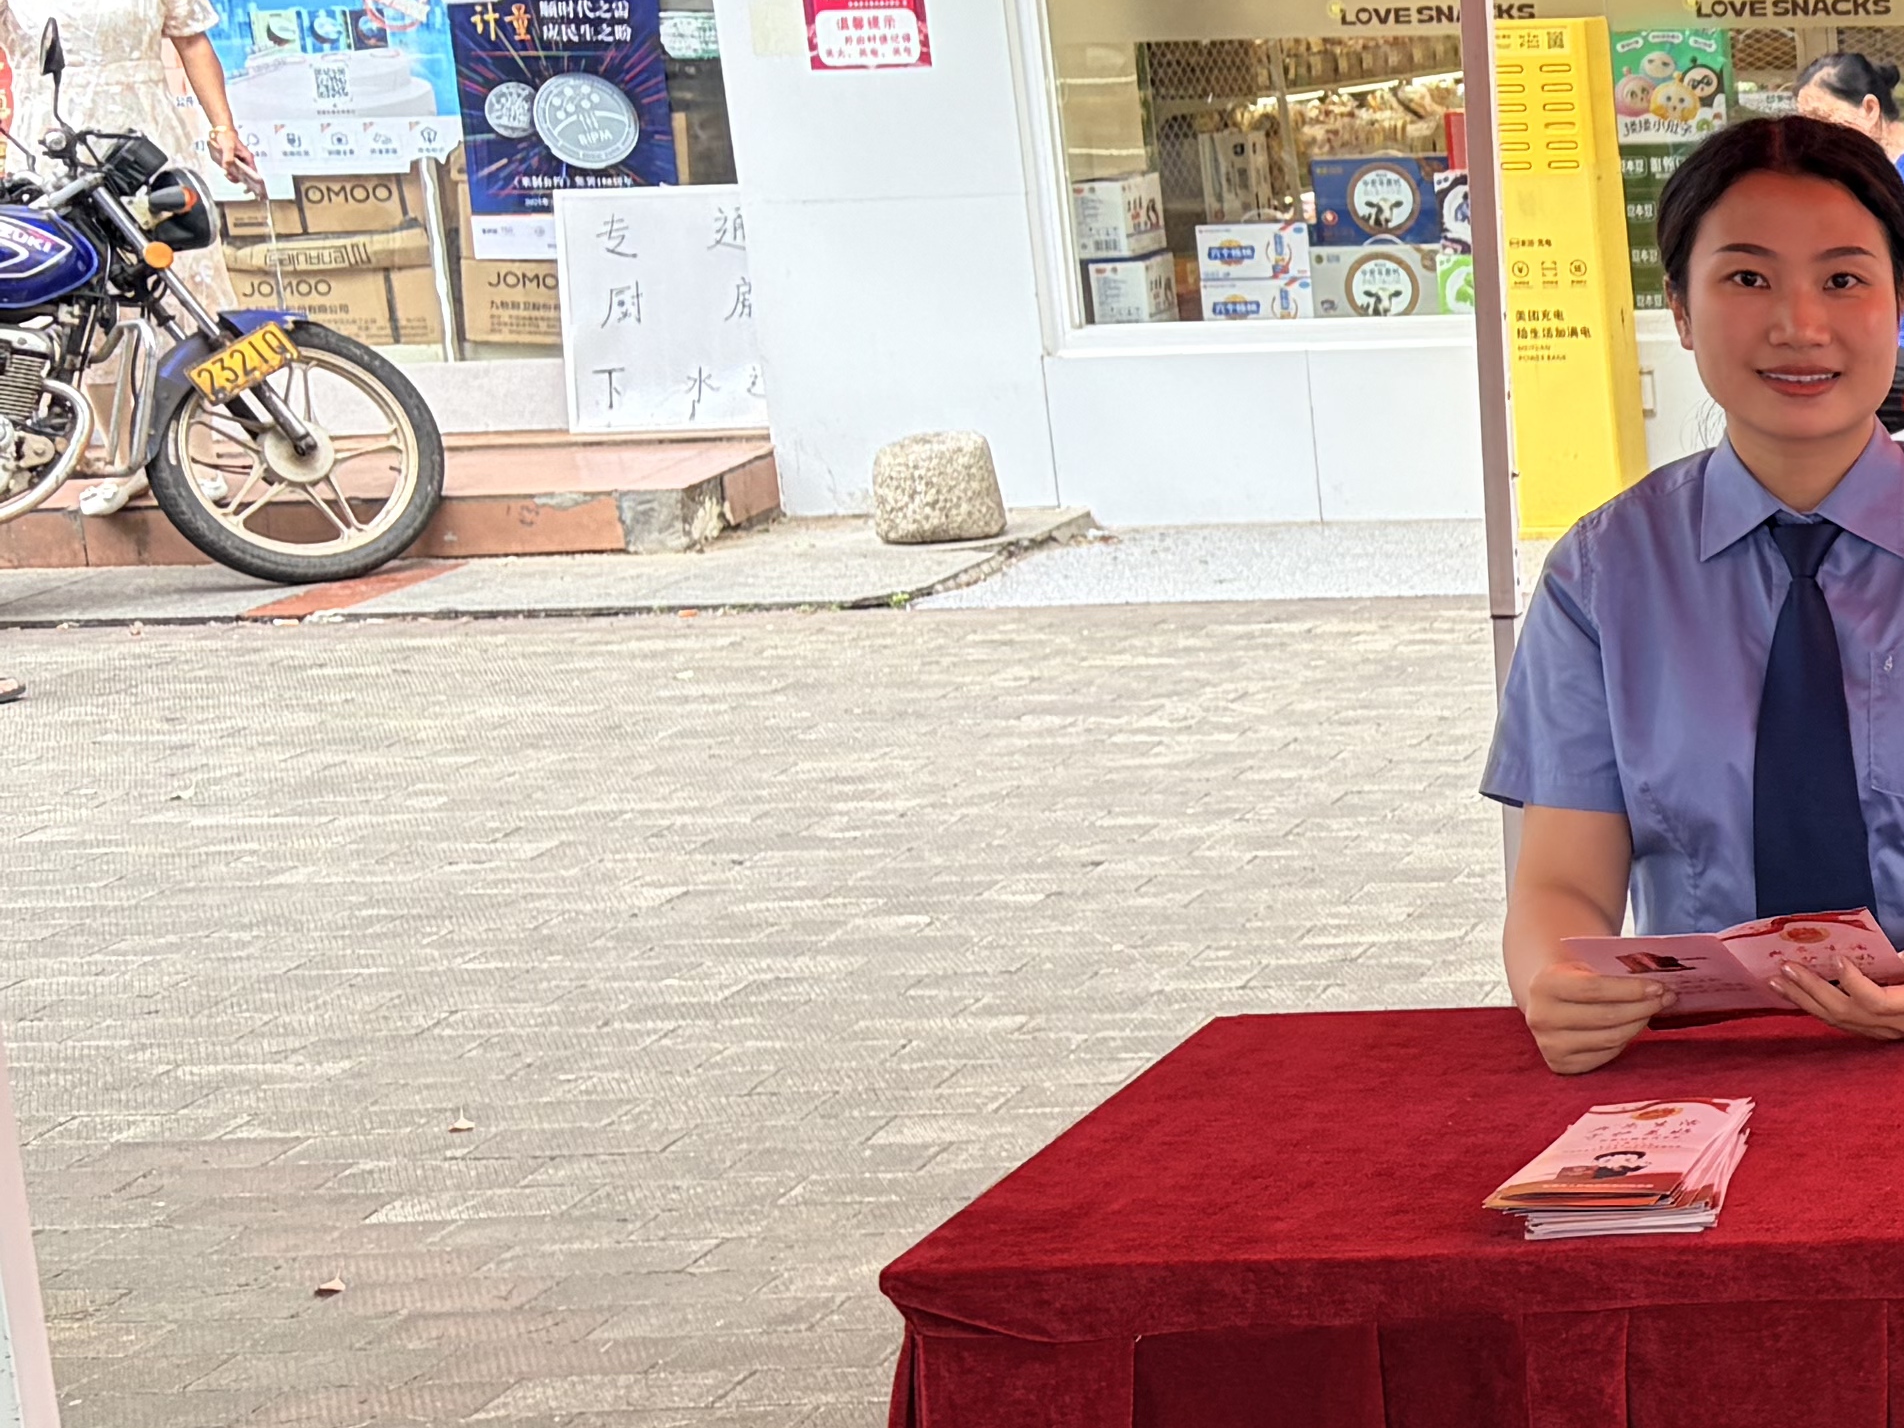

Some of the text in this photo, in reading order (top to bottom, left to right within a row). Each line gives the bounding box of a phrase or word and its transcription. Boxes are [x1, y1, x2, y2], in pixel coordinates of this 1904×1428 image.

[1340, 3, 1536, 26] LOVE SNKS
[1696, 0, 1768, 18] LOVE
[471, 2, 531, 41] 计量
[304, 182, 393, 204] OMOO
